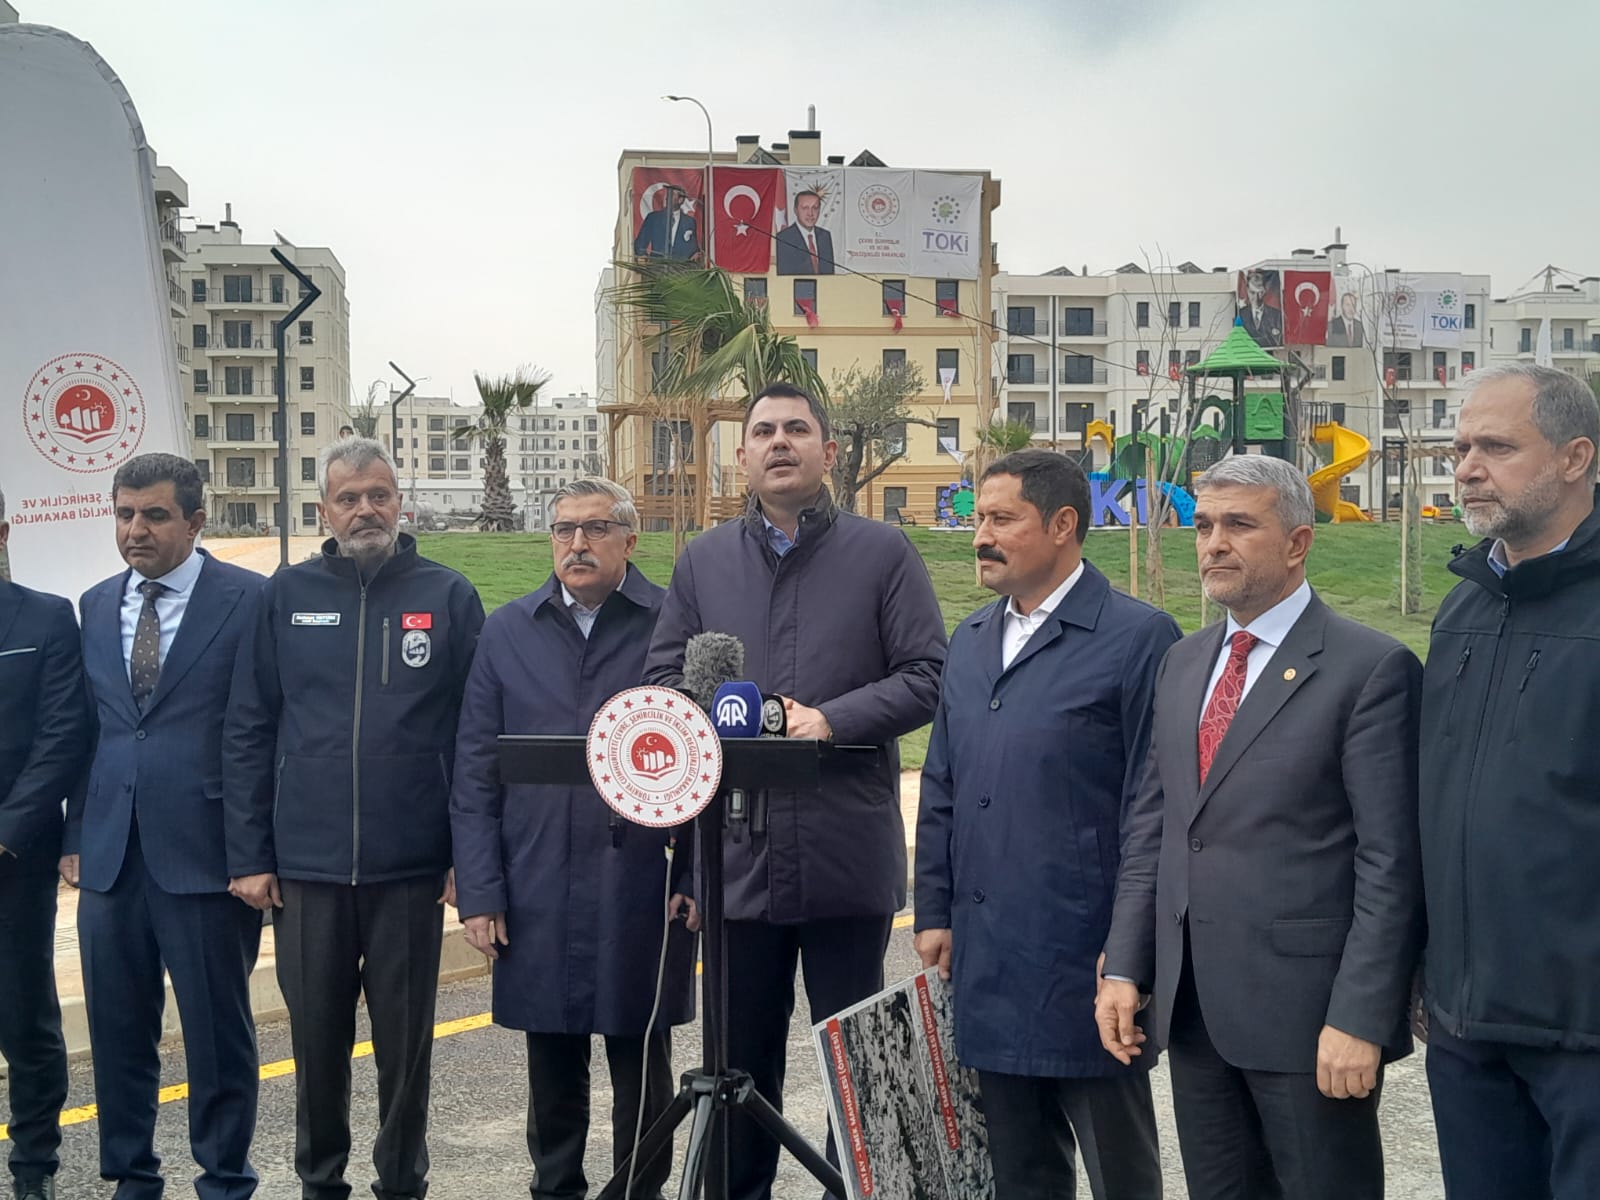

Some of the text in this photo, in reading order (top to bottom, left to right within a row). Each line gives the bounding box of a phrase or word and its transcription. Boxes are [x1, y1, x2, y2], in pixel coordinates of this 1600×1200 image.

[629, 710, 664, 724] ŞEHİRCİLİK
[664, 713, 672, 723] VE
[717, 702, 748, 727] AA
[673, 719, 689, 737] İKLİM
[612, 739, 627, 785] CUMHURİYETİ
[685, 736, 697, 777] DEĞİŞİKLİĞİ
[626, 782, 650, 801] TÜRKİYE
[664, 776, 692, 801] BAKANLIĞI
[830, 1030, 847, 1074] (ÖNCESİ)
[928, 1034, 944, 1082] MAHALLESİ
[839, 1075, 856, 1125] MAHALLESİ
[939, 1083, 949, 1107] EMEK
[851, 1127, 862, 1151] EMEK
[946, 1115, 958, 1145] HATAY
[858, 1159, 871, 1192] HATAY
